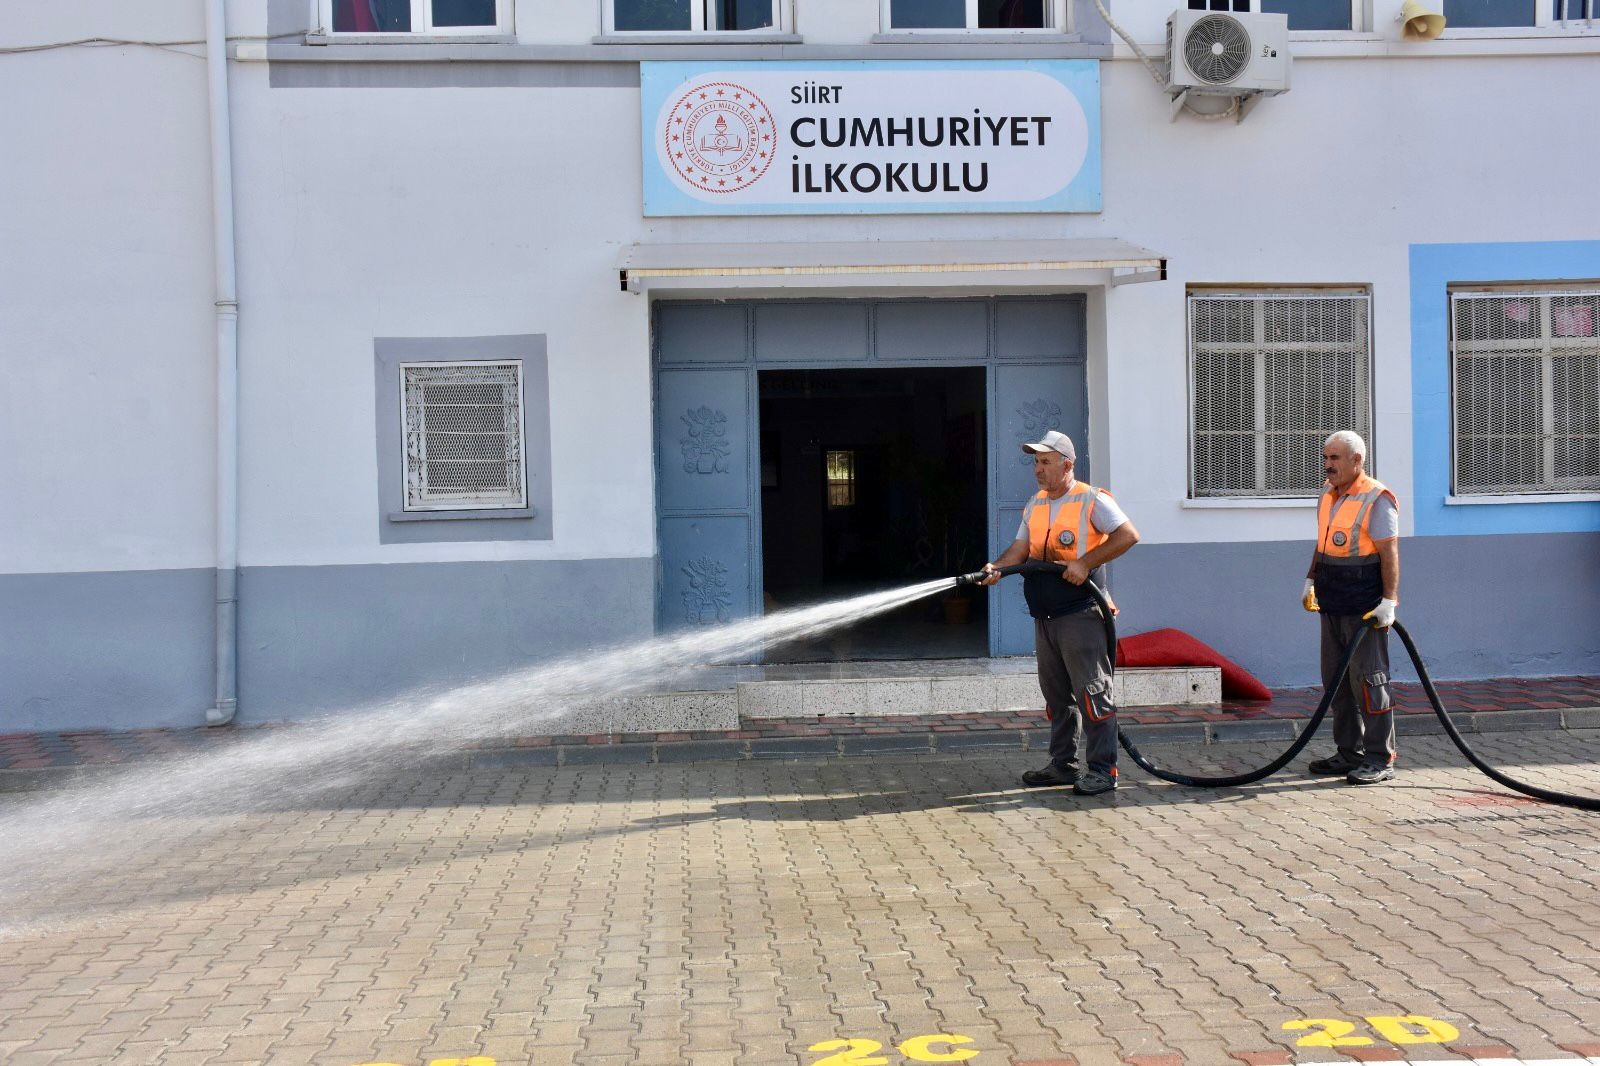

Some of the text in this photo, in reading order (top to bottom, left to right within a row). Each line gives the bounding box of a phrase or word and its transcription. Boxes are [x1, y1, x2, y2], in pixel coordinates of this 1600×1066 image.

[791, 81, 843, 104] SİİRT
[790, 108, 1052, 147] CUMHURİYET
[792, 154, 989, 193] İLKOKULU
[1281, 1015, 1461, 1047] 2D
[807, 1034, 981, 1066] 2C
